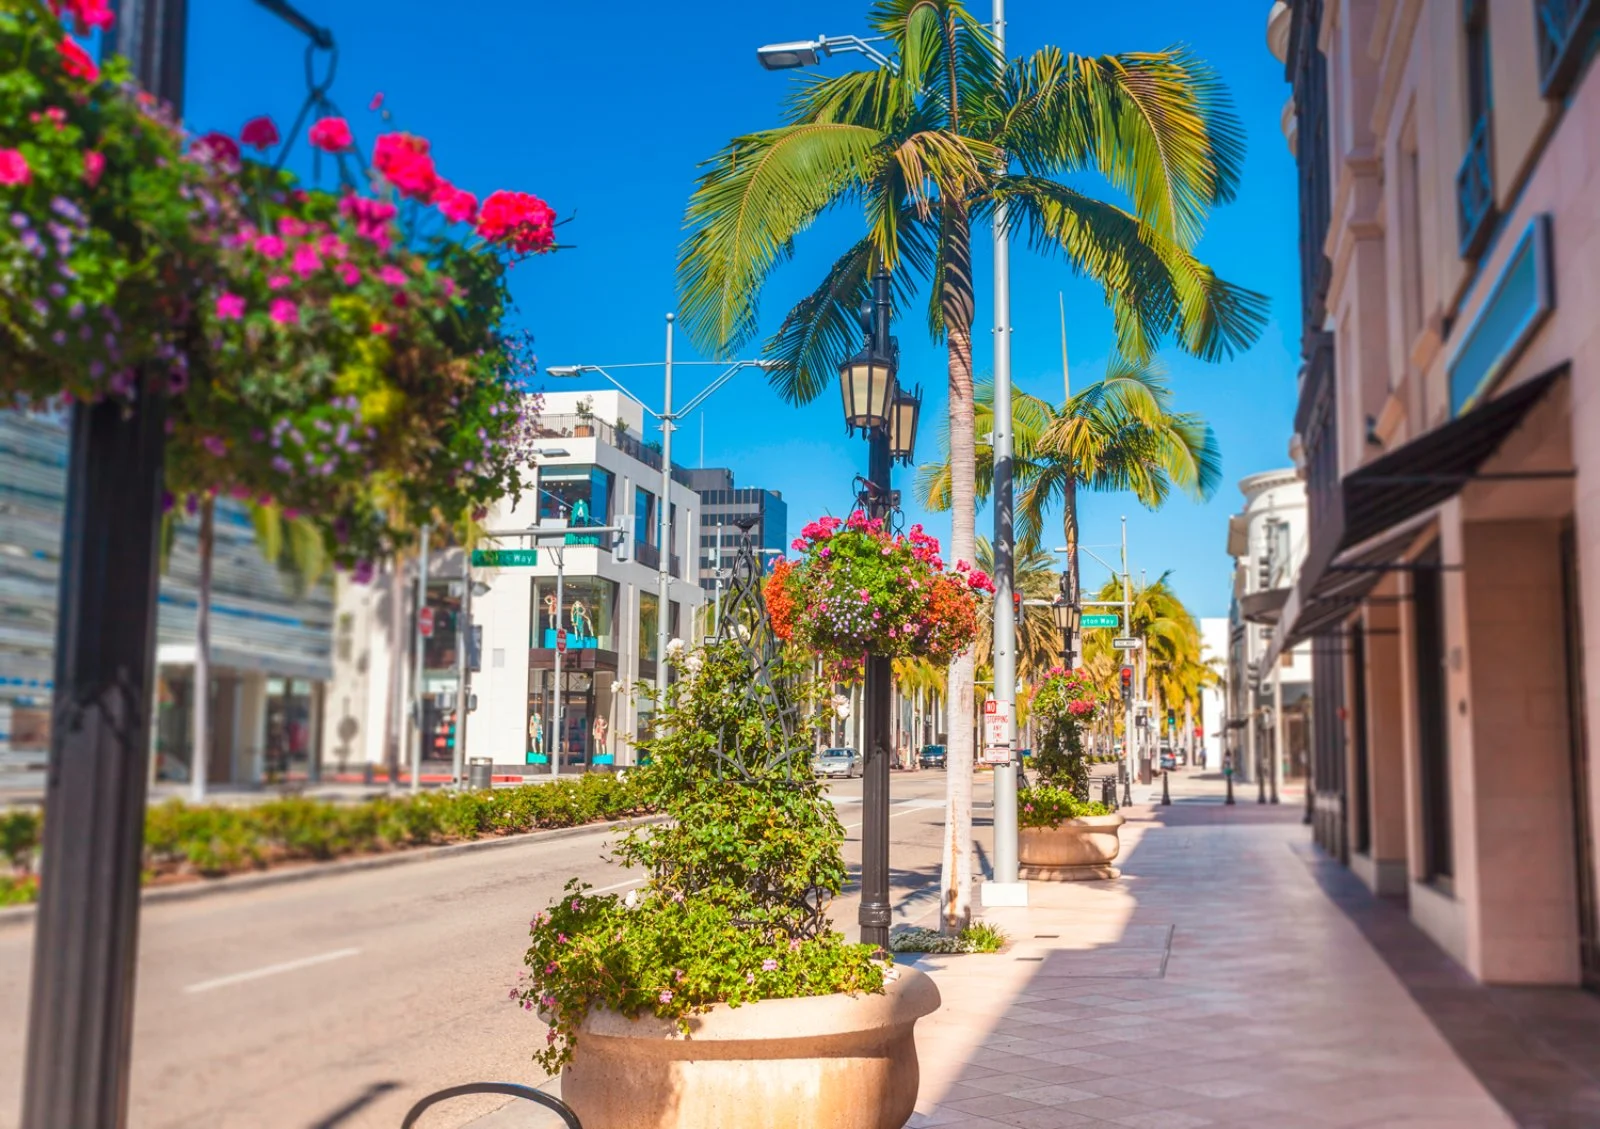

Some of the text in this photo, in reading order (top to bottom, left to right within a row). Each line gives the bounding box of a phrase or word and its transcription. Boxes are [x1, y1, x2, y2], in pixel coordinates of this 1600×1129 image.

[513, 554, 532, 564] Way
[986, 701, 996, 713] NO
[987, 715, 1008, 723] STOPPING
